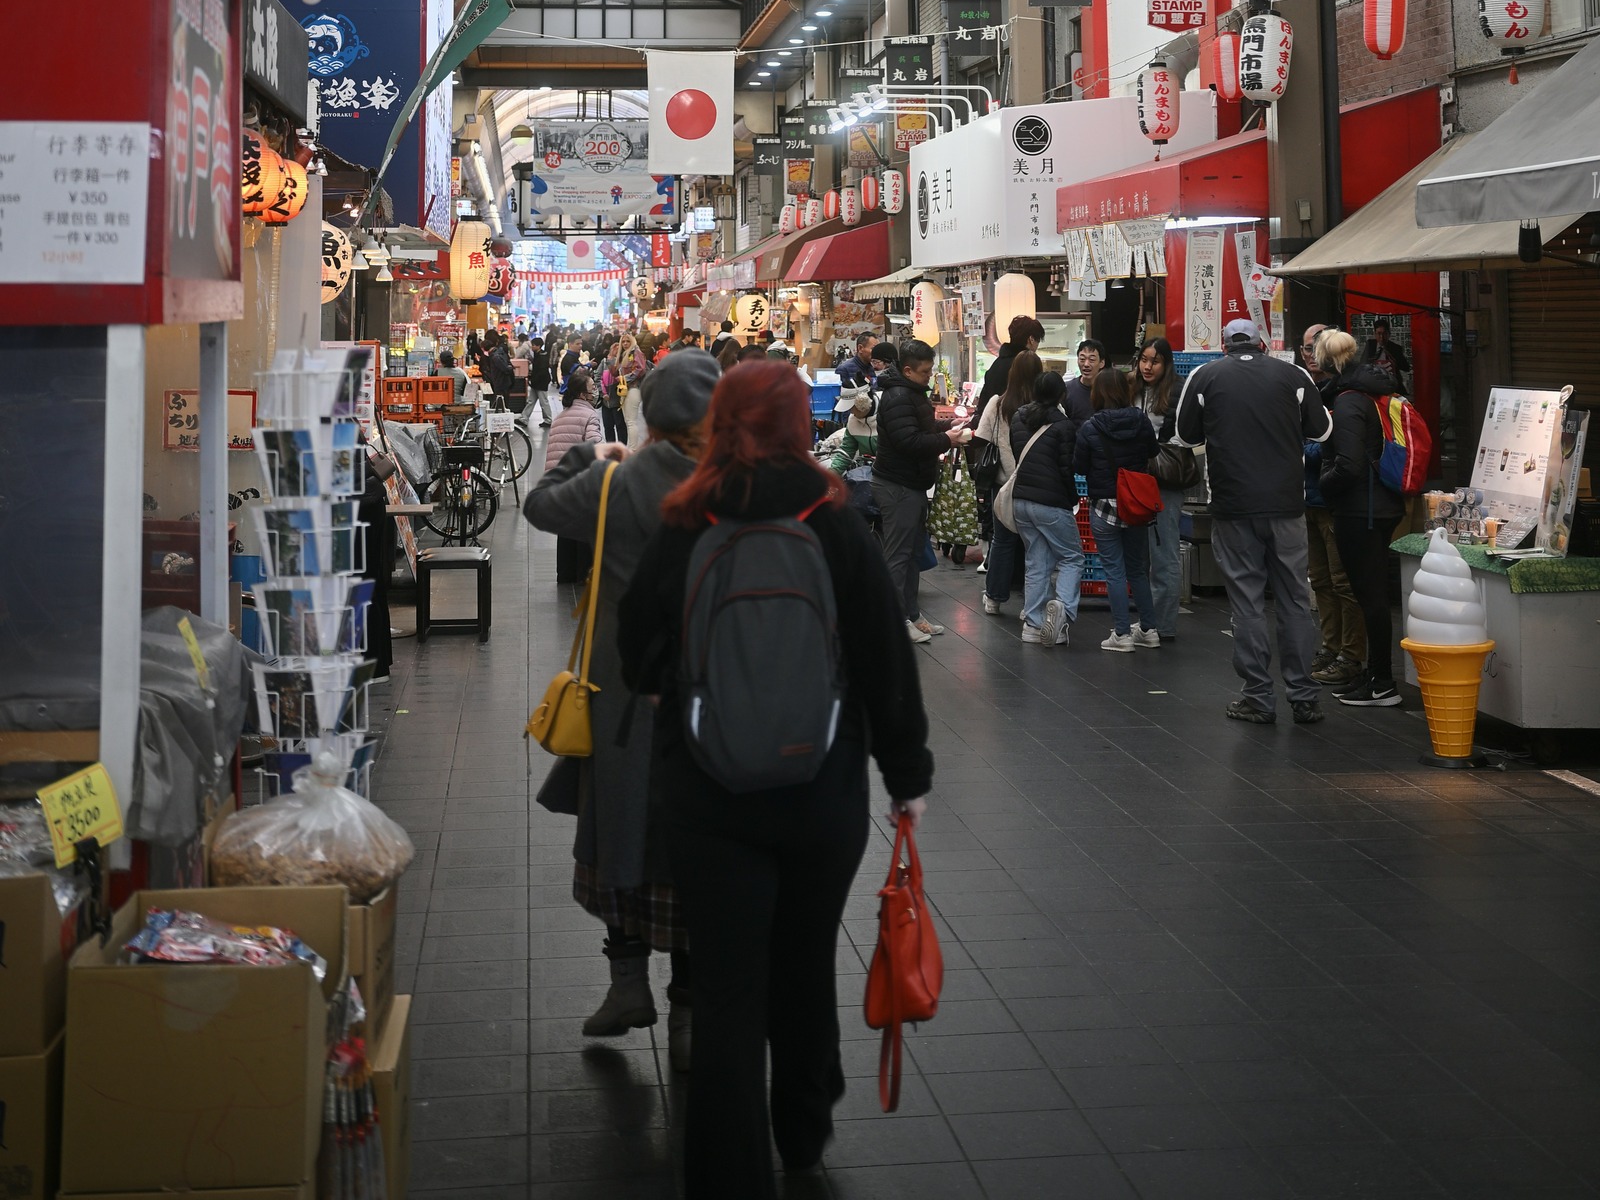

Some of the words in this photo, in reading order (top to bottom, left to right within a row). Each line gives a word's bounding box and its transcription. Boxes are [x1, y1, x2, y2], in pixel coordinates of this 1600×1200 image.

[1152, 1, 1203, 11] STAMP
[1152, 12, 1203, 25] 加盟店
[1240, 17, 1267, 92] 黒門市場
[1270, 19, 1293, 96] ほんまもん
[892, 67, 929, 82] 丸岩
[1153, 71, 1171, 135] ほんまもん
[585, 141, 621, 156] 200
[897, 133, 928, 141] STAMP
[547, 154, 560, 166] 祝
[1013, 157, 1054, 176] 美月
[846, 189, 856, 224] ほんまもん
[891, 173, 901, 211] ほんまもん
[931, 166, 953, 214] 美月
[1029, 192, 1040, 247] 黒門市場店
[1192, 264, 1201, 313] ソフトクリーム
[1200, 263, 1215, 312] 濃い豆乳
[748, 299, 765, 328] 寿し
[915, 289, 923, 326] 日本三大和牛
